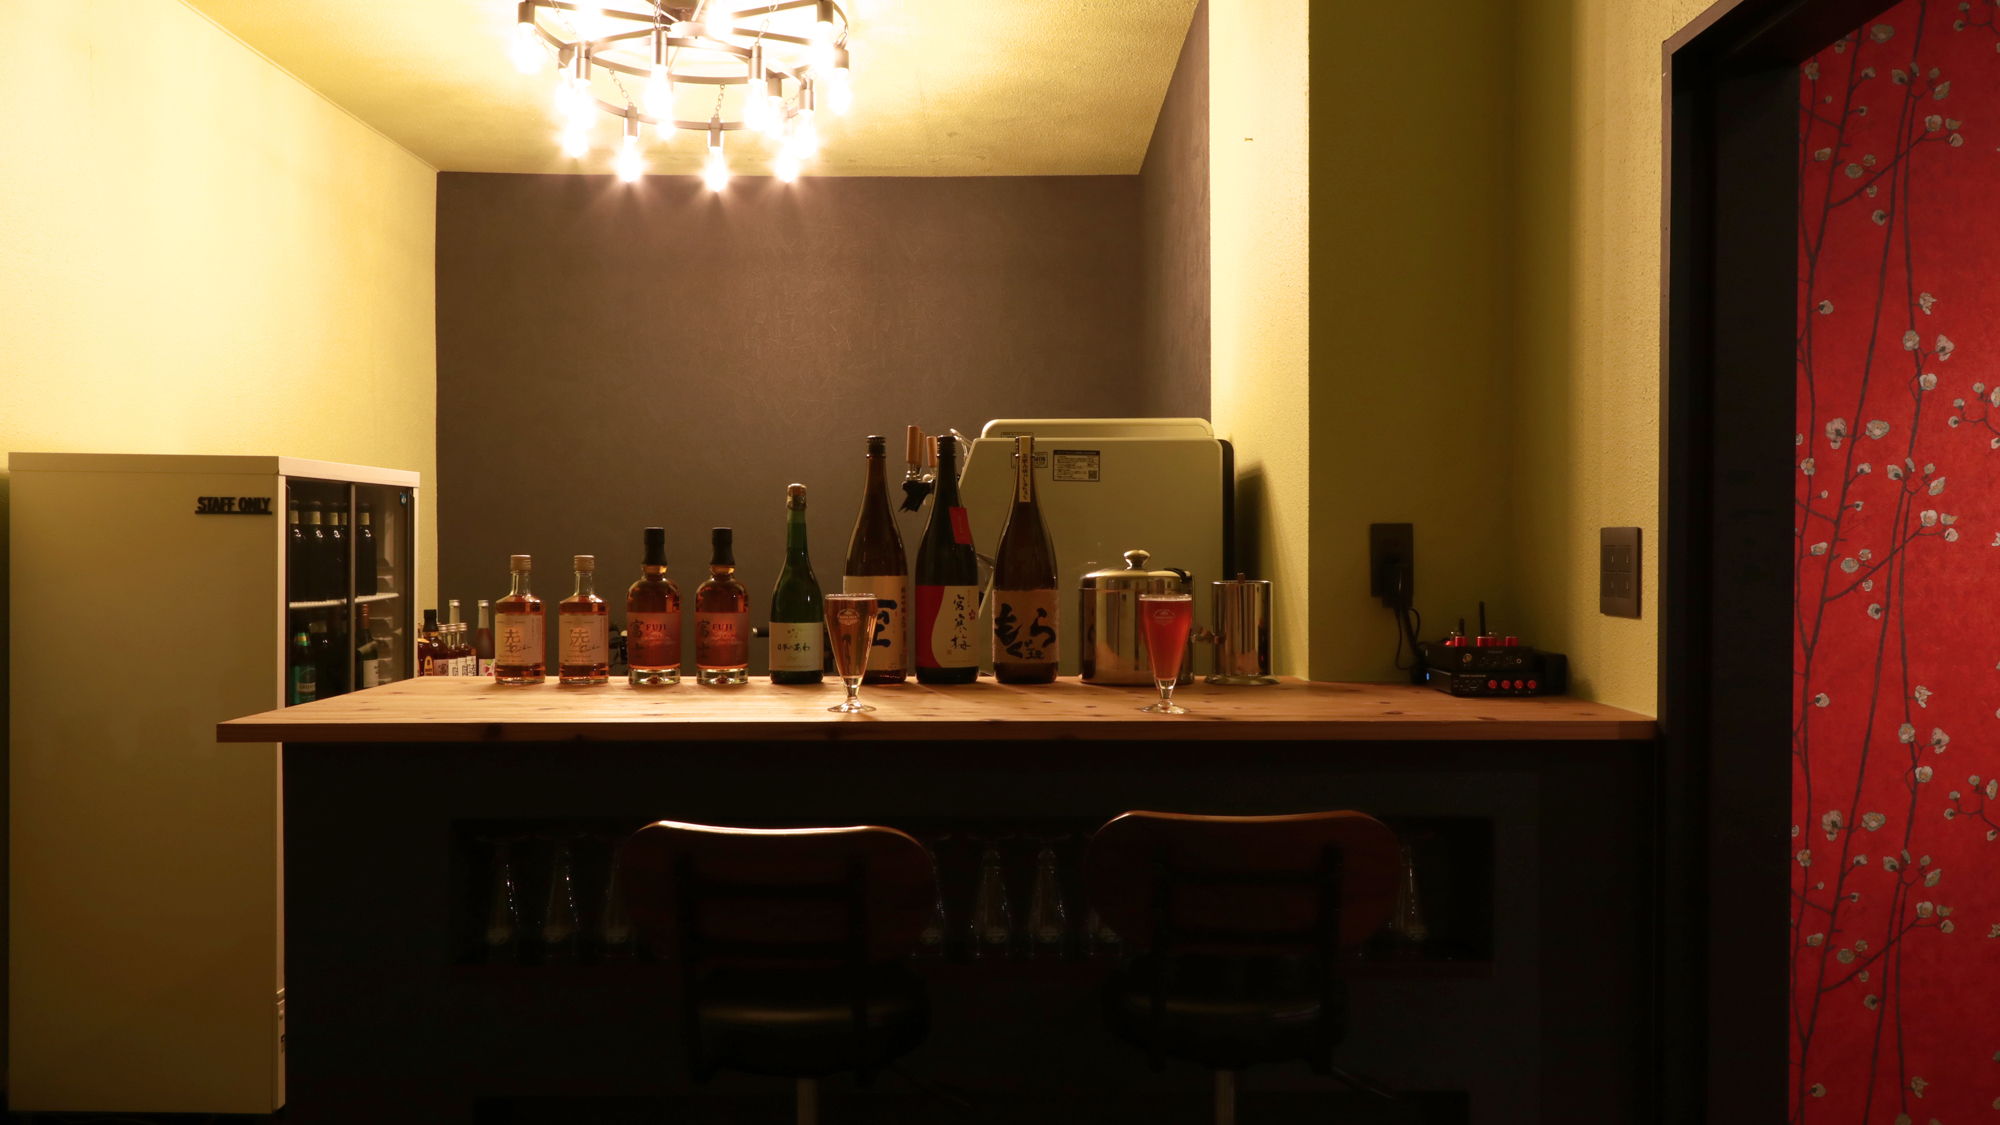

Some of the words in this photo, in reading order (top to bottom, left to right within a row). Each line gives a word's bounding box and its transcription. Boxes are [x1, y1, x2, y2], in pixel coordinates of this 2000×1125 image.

[197, 496, 236, 513] STAFF
[238, 497, 271, 513] ONLY
[646, 623, 667, 631] FUJI
[712, 623, 734, 631] FUJI
